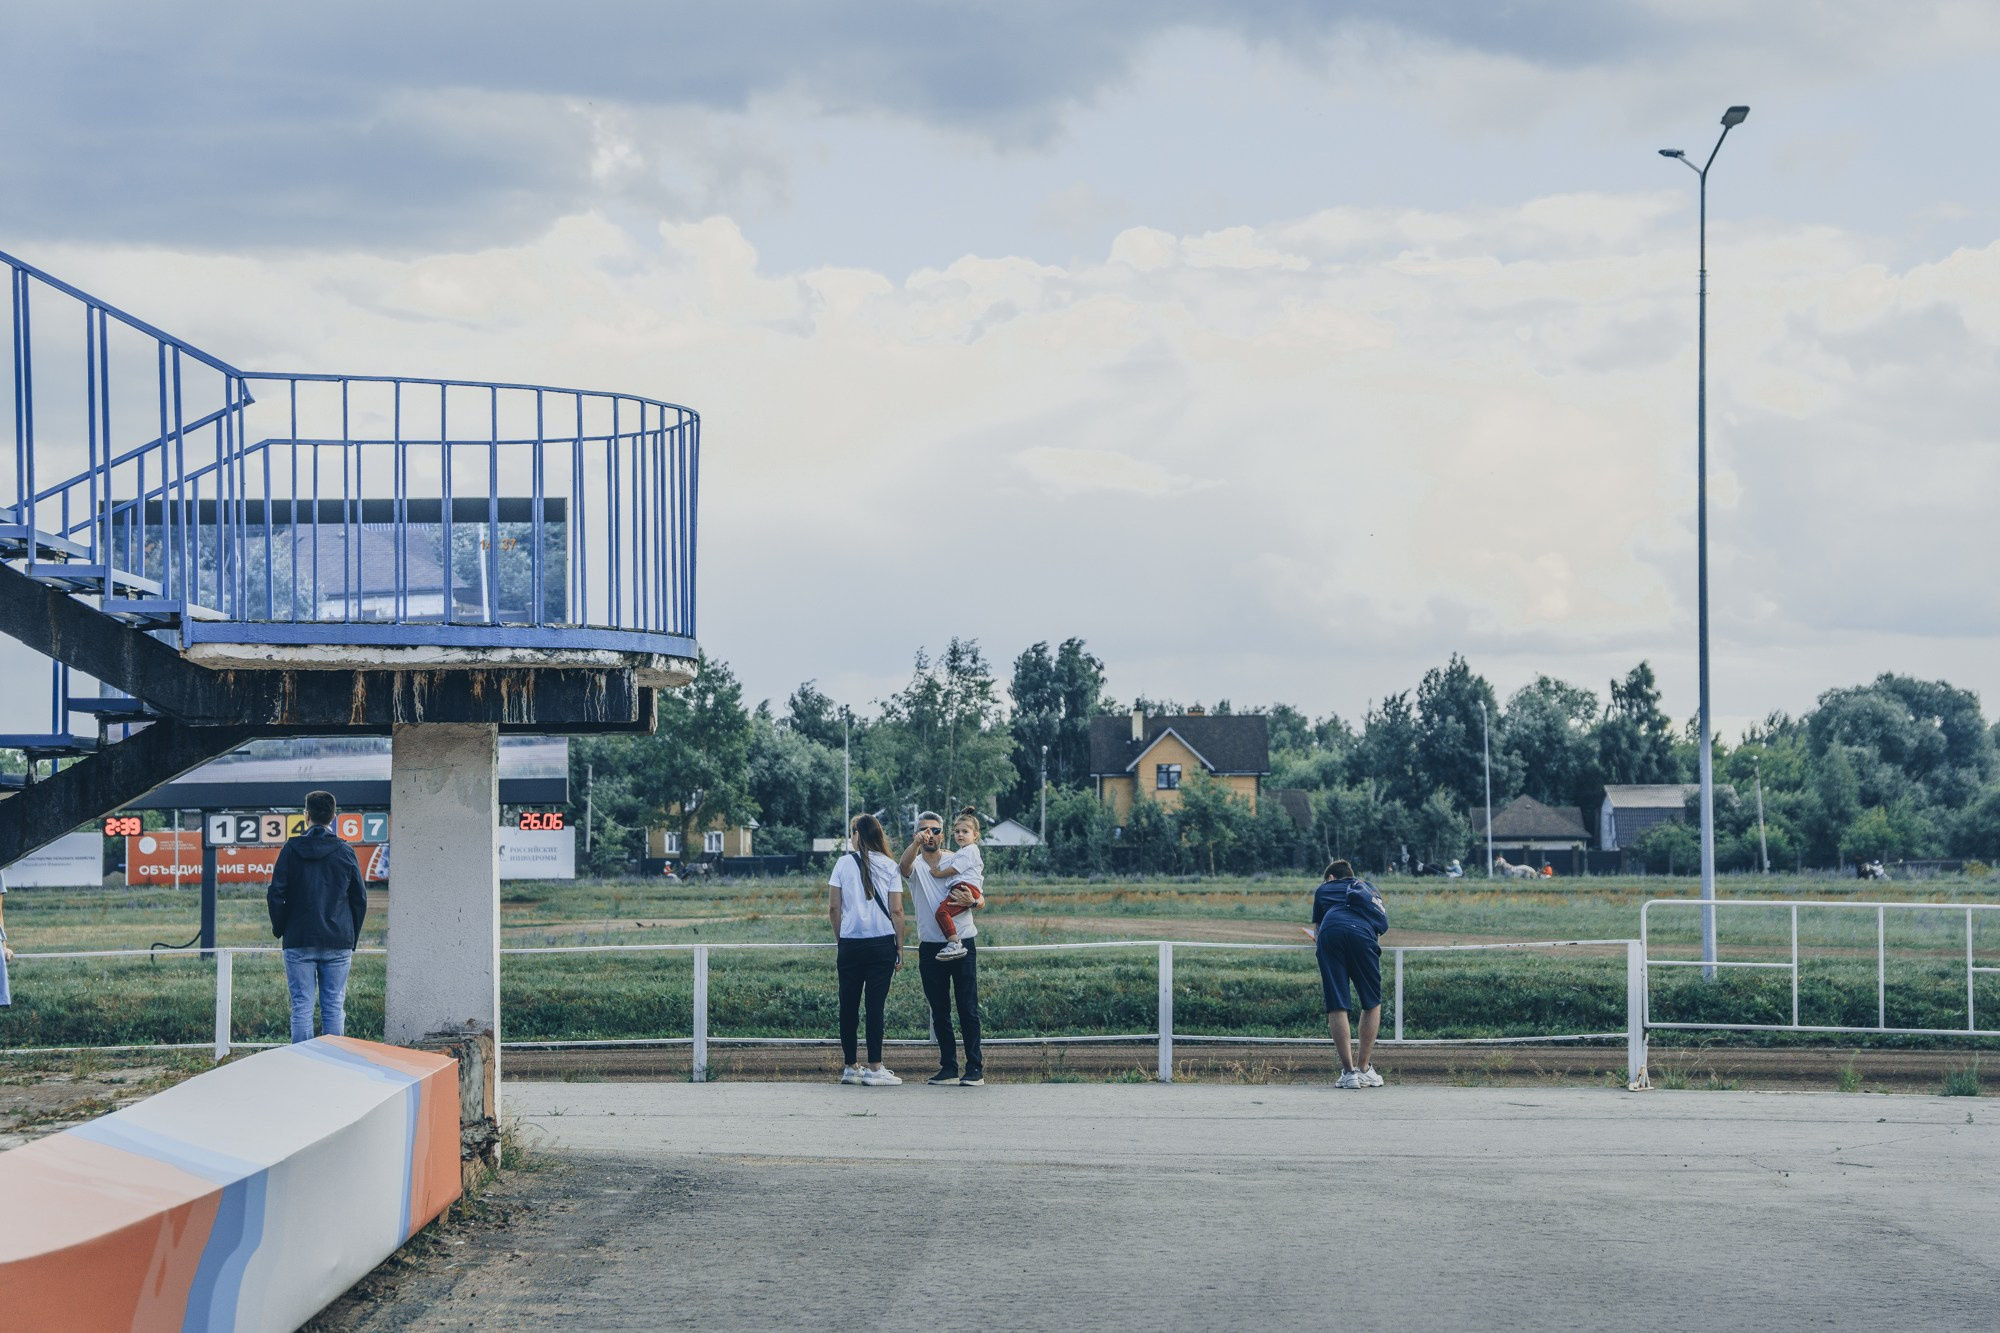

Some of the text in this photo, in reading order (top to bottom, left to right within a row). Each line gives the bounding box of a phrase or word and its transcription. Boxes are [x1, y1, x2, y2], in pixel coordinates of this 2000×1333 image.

[105, 817, 141, 836] 2:39
[216, 821, 227, 838] 1
[239, 820, 257, 839] 2
[266, 821, 281, 838] 3
[291, 820, 306, 834] 4
[342, 820, 359, 837] 6
[367, 819, 384, 836] 7
[520, 813, 563, 830] 26.06
[139, 863, 275, 876] ОБЪЕДИНИЕ РАД
